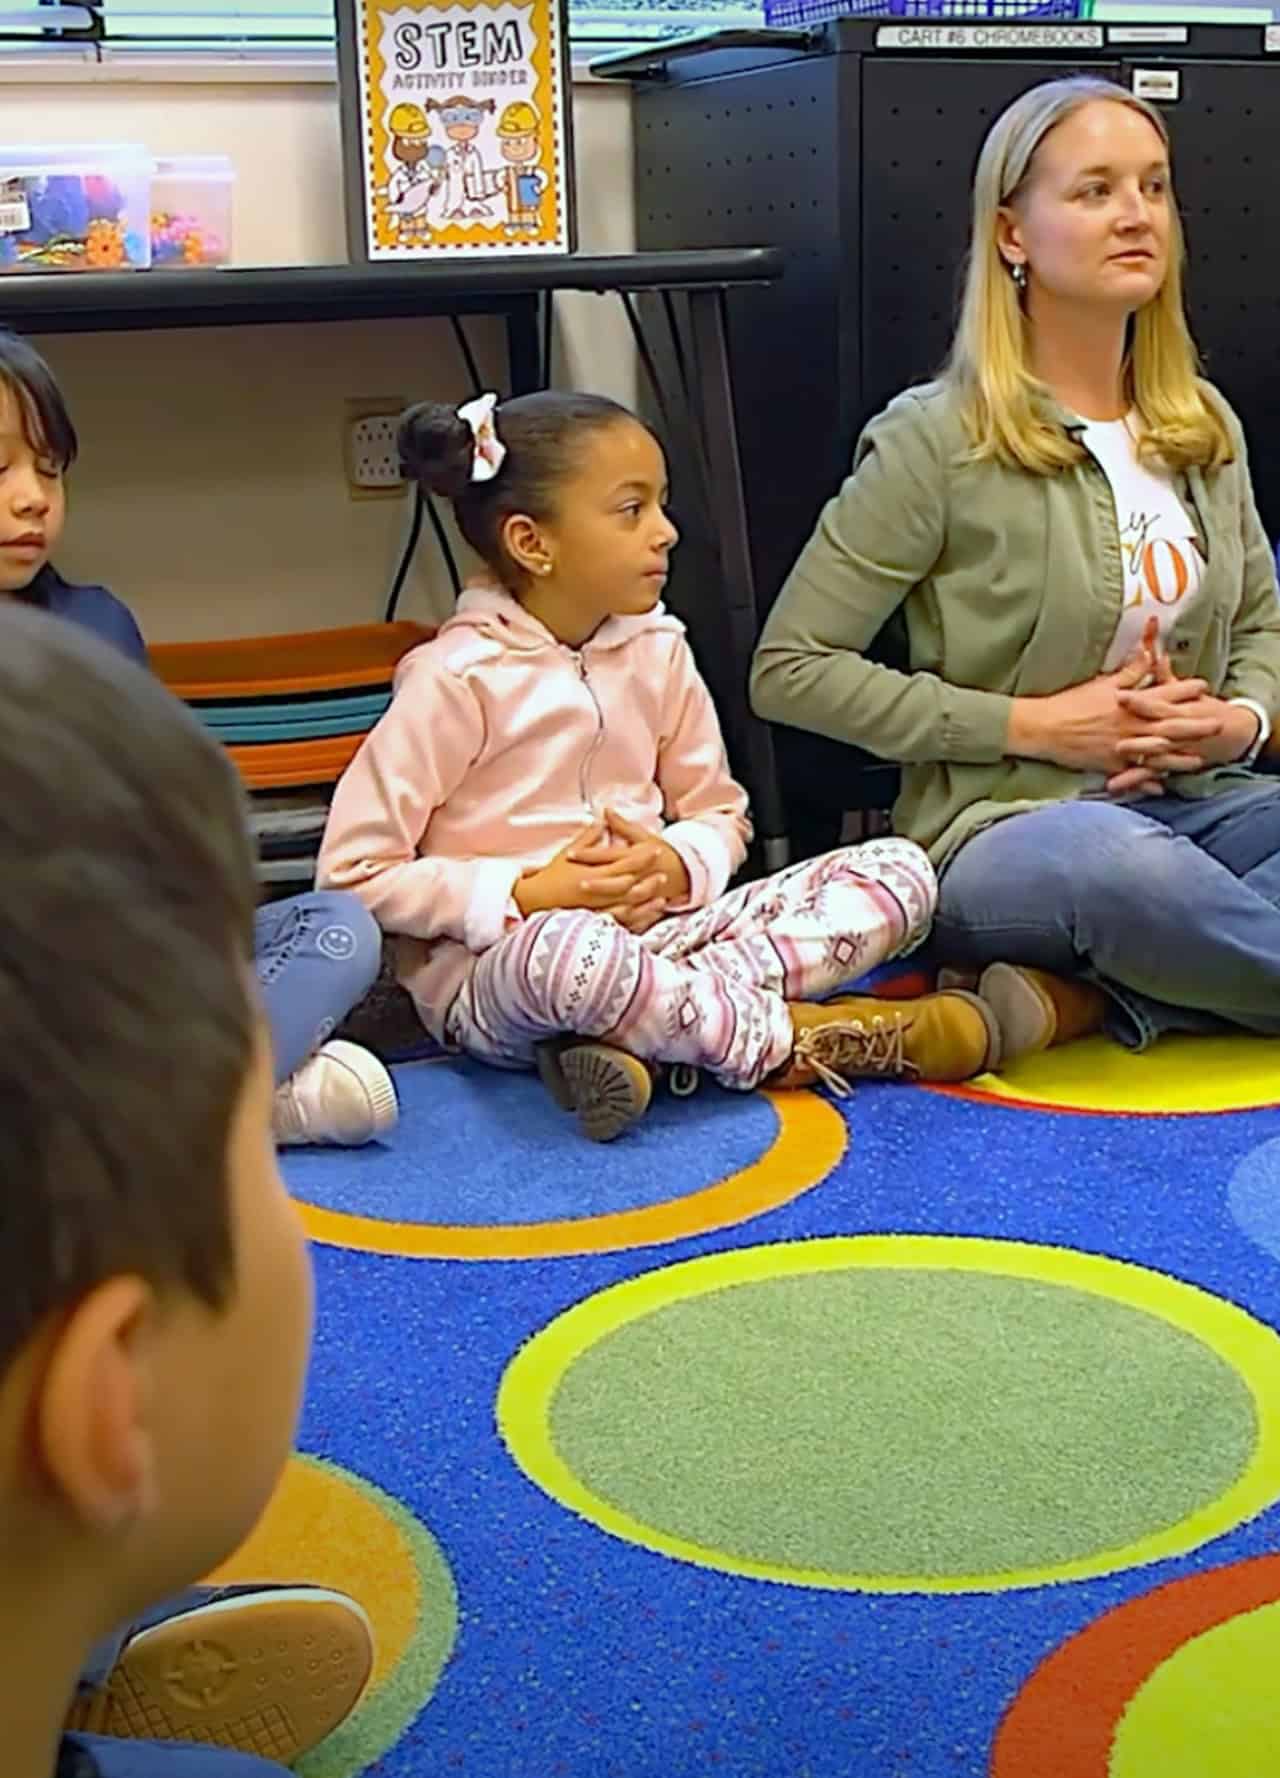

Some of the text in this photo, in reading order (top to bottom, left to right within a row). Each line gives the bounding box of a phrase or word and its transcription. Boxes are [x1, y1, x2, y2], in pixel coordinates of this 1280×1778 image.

[393, 19, 523, 70] STEM
[897, 29, 942, 45] CART
[973, 29, 1098, 46] CHROMEBOOKS
[392, 72, 465, 90] ACTIVITY
